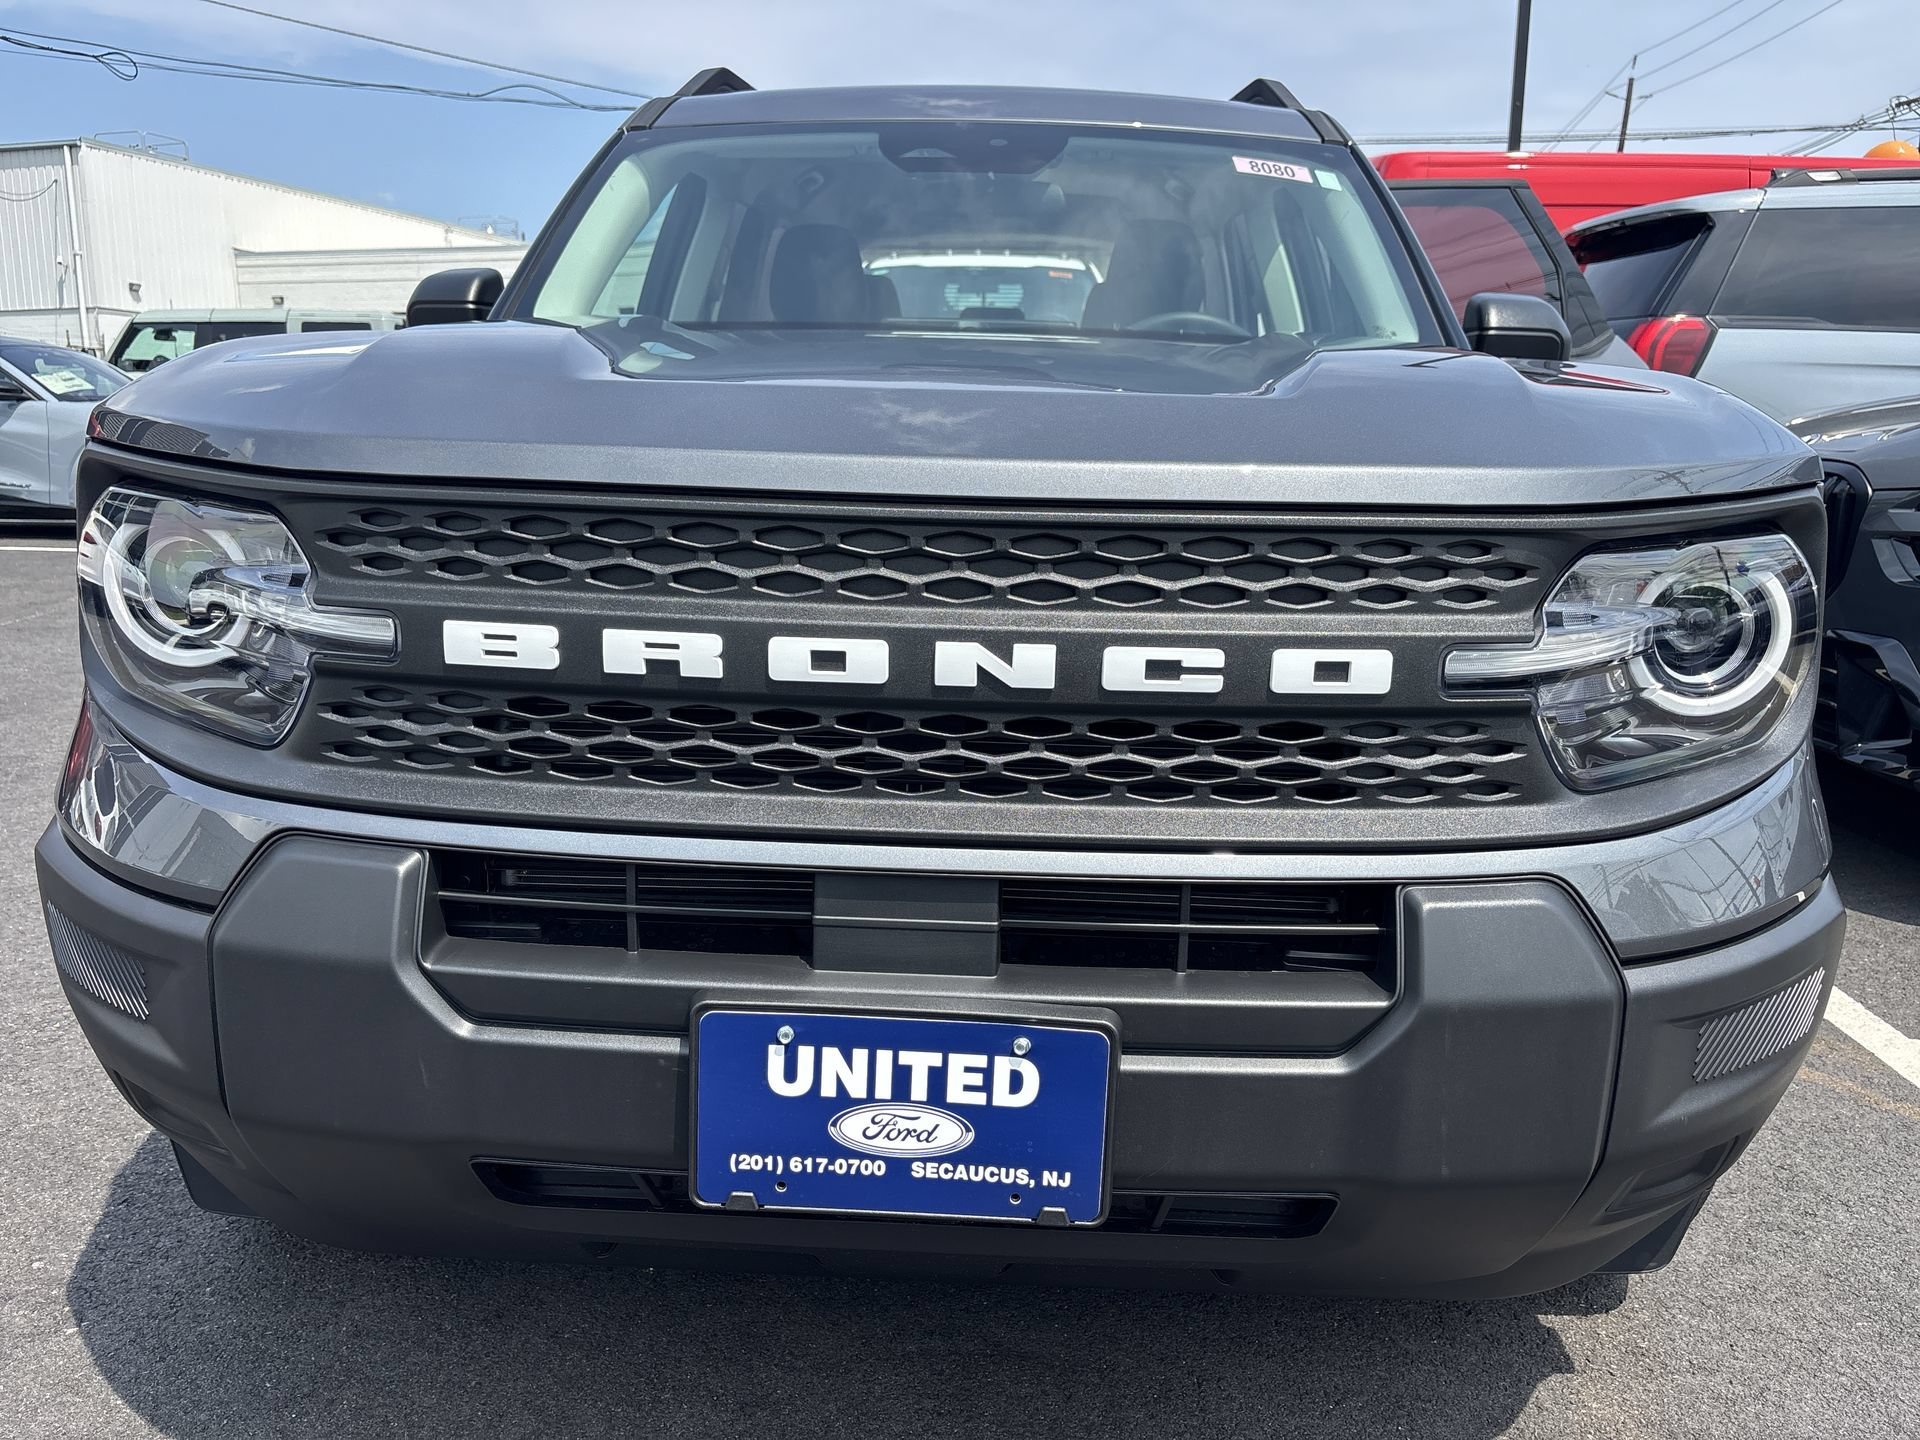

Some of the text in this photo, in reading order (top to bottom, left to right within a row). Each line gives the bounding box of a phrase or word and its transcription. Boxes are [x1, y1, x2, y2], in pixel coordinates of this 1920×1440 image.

[1250, 161, 1296, 178] 8080
[442, 619, 1394, 695] BRONCO
[767, 1044, 1040, 1108] UNITED
[861, 1111, 938, 1144] Ford
[729, 1153, 887, 1177] (201) 617-0700
[910, 1161, 1071, 1189] SECAUCUS, NJ
